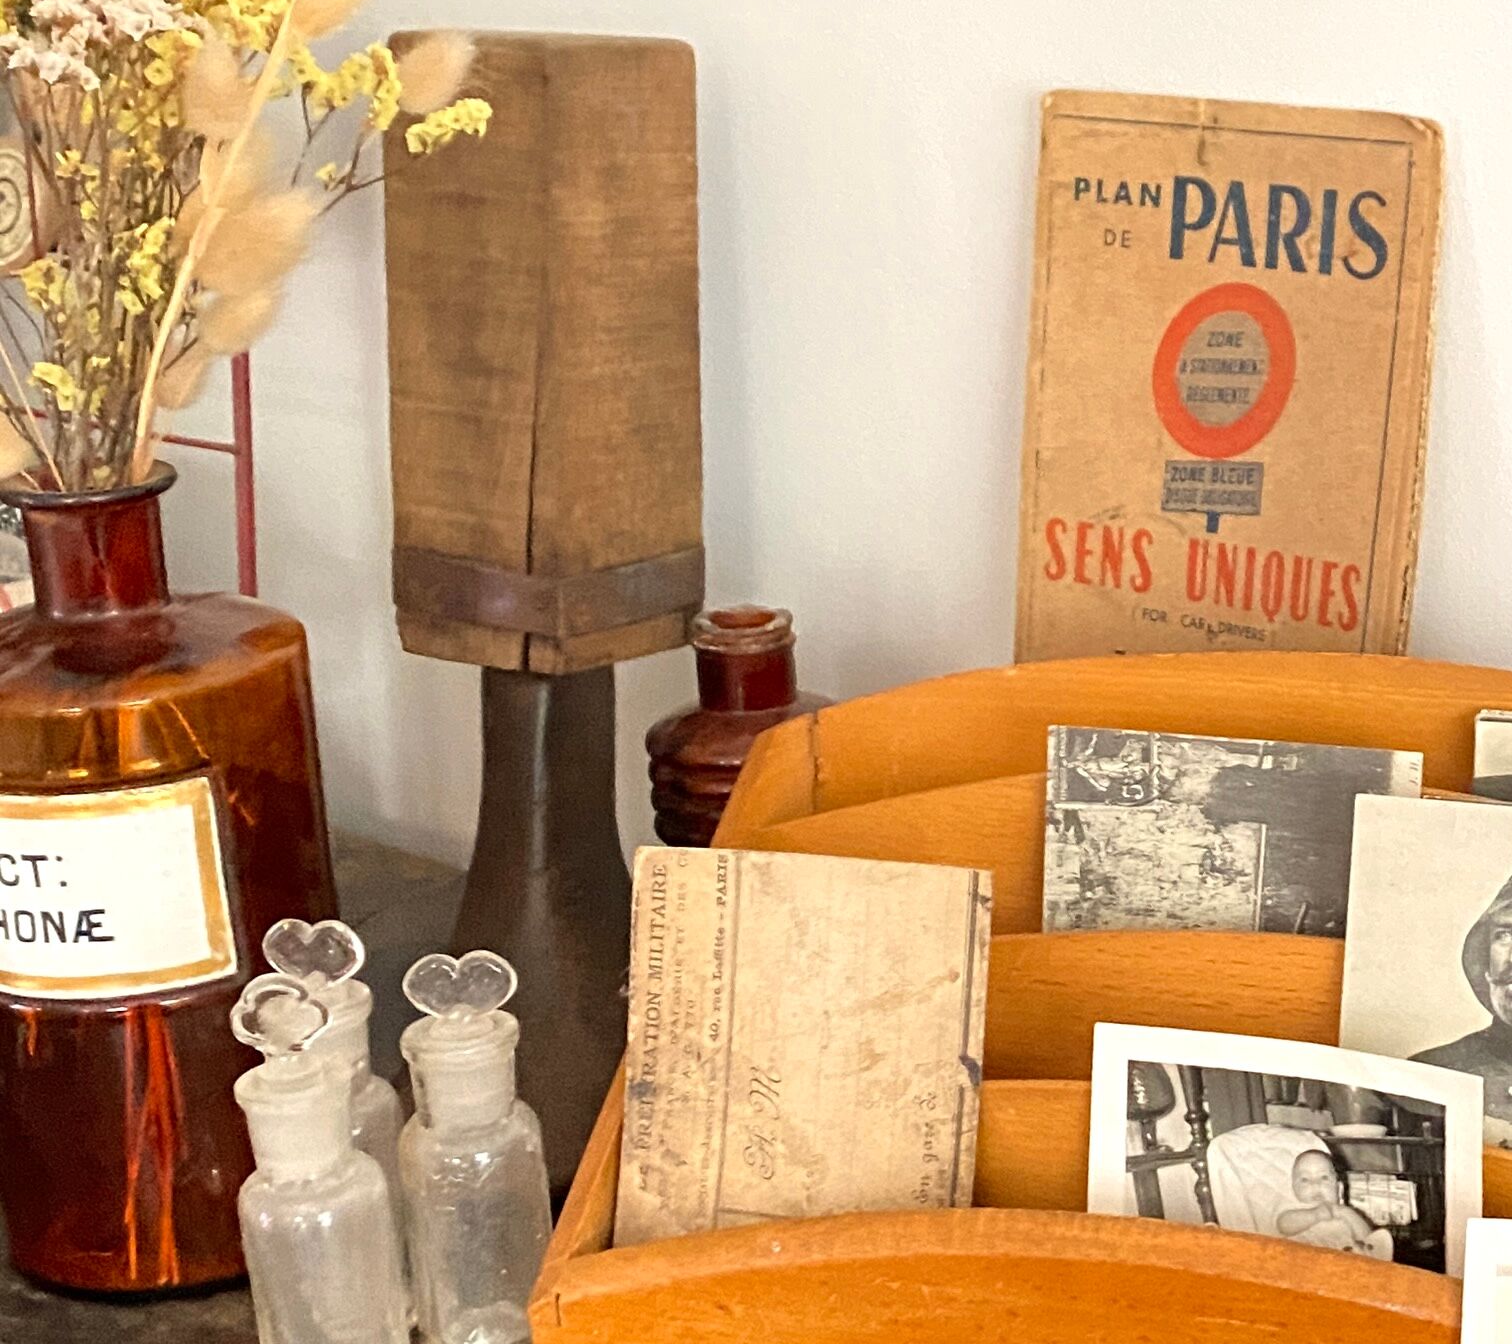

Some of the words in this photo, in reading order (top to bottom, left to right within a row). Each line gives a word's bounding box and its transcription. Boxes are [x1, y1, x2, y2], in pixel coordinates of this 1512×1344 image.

[1073, 177, 1163, 207] PLAN
[1169, 175, 1389, 280] PARIS
[1103, 228, 1132, 249] DE
[1206, 330, 1245, 348] ZONE
[1170, 465, 1206, 483] ZONE
[1211, 466, 1255, 485] BLEUE
[1045, 516, 1155, 595] SENS
[1186, 537, 1363, 632] UNIQUES
[714, 854, 730, 909] PARIS
[647, 864, 669, 981] MILITAIRE
